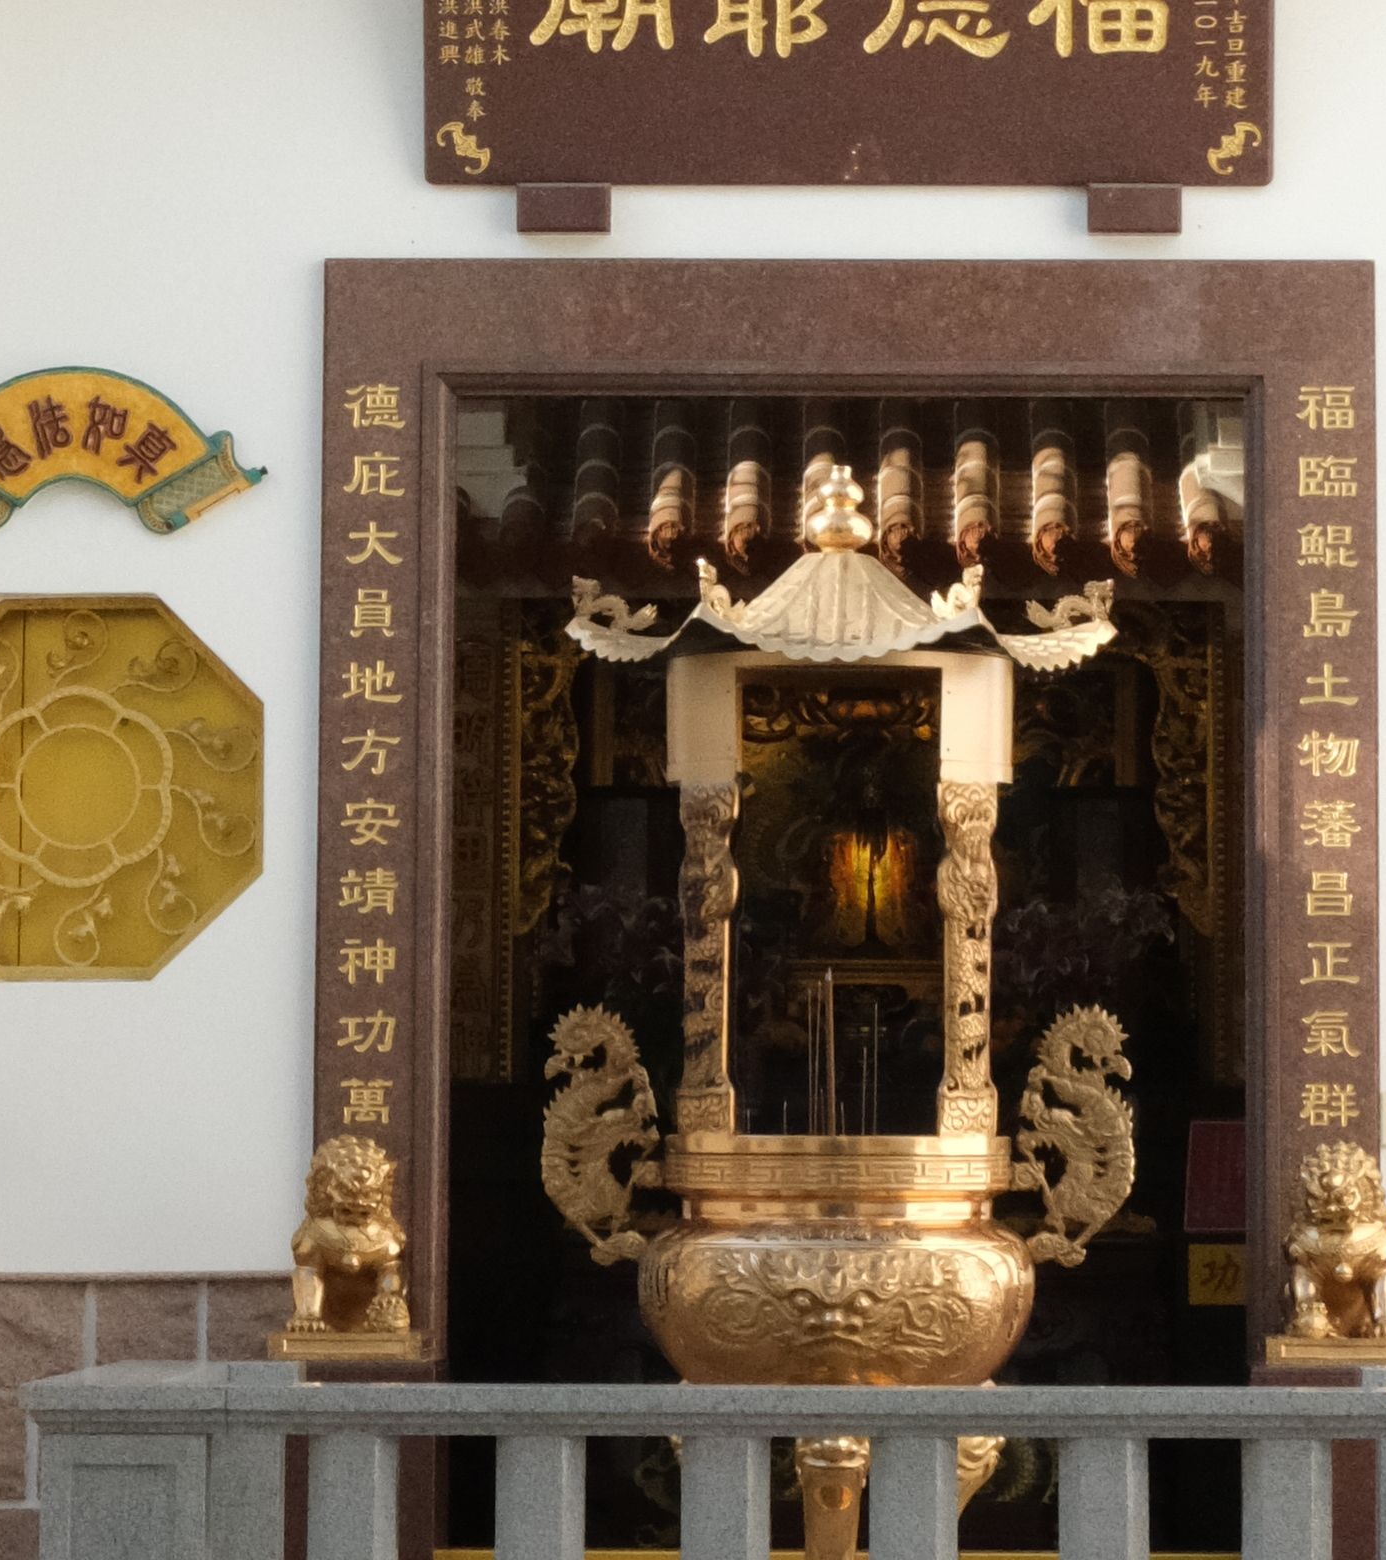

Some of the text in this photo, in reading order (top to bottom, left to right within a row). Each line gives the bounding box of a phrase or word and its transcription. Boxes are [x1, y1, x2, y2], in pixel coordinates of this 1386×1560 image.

[338, 383, 406, 1125] 德庇大員地方安靖神功萬
